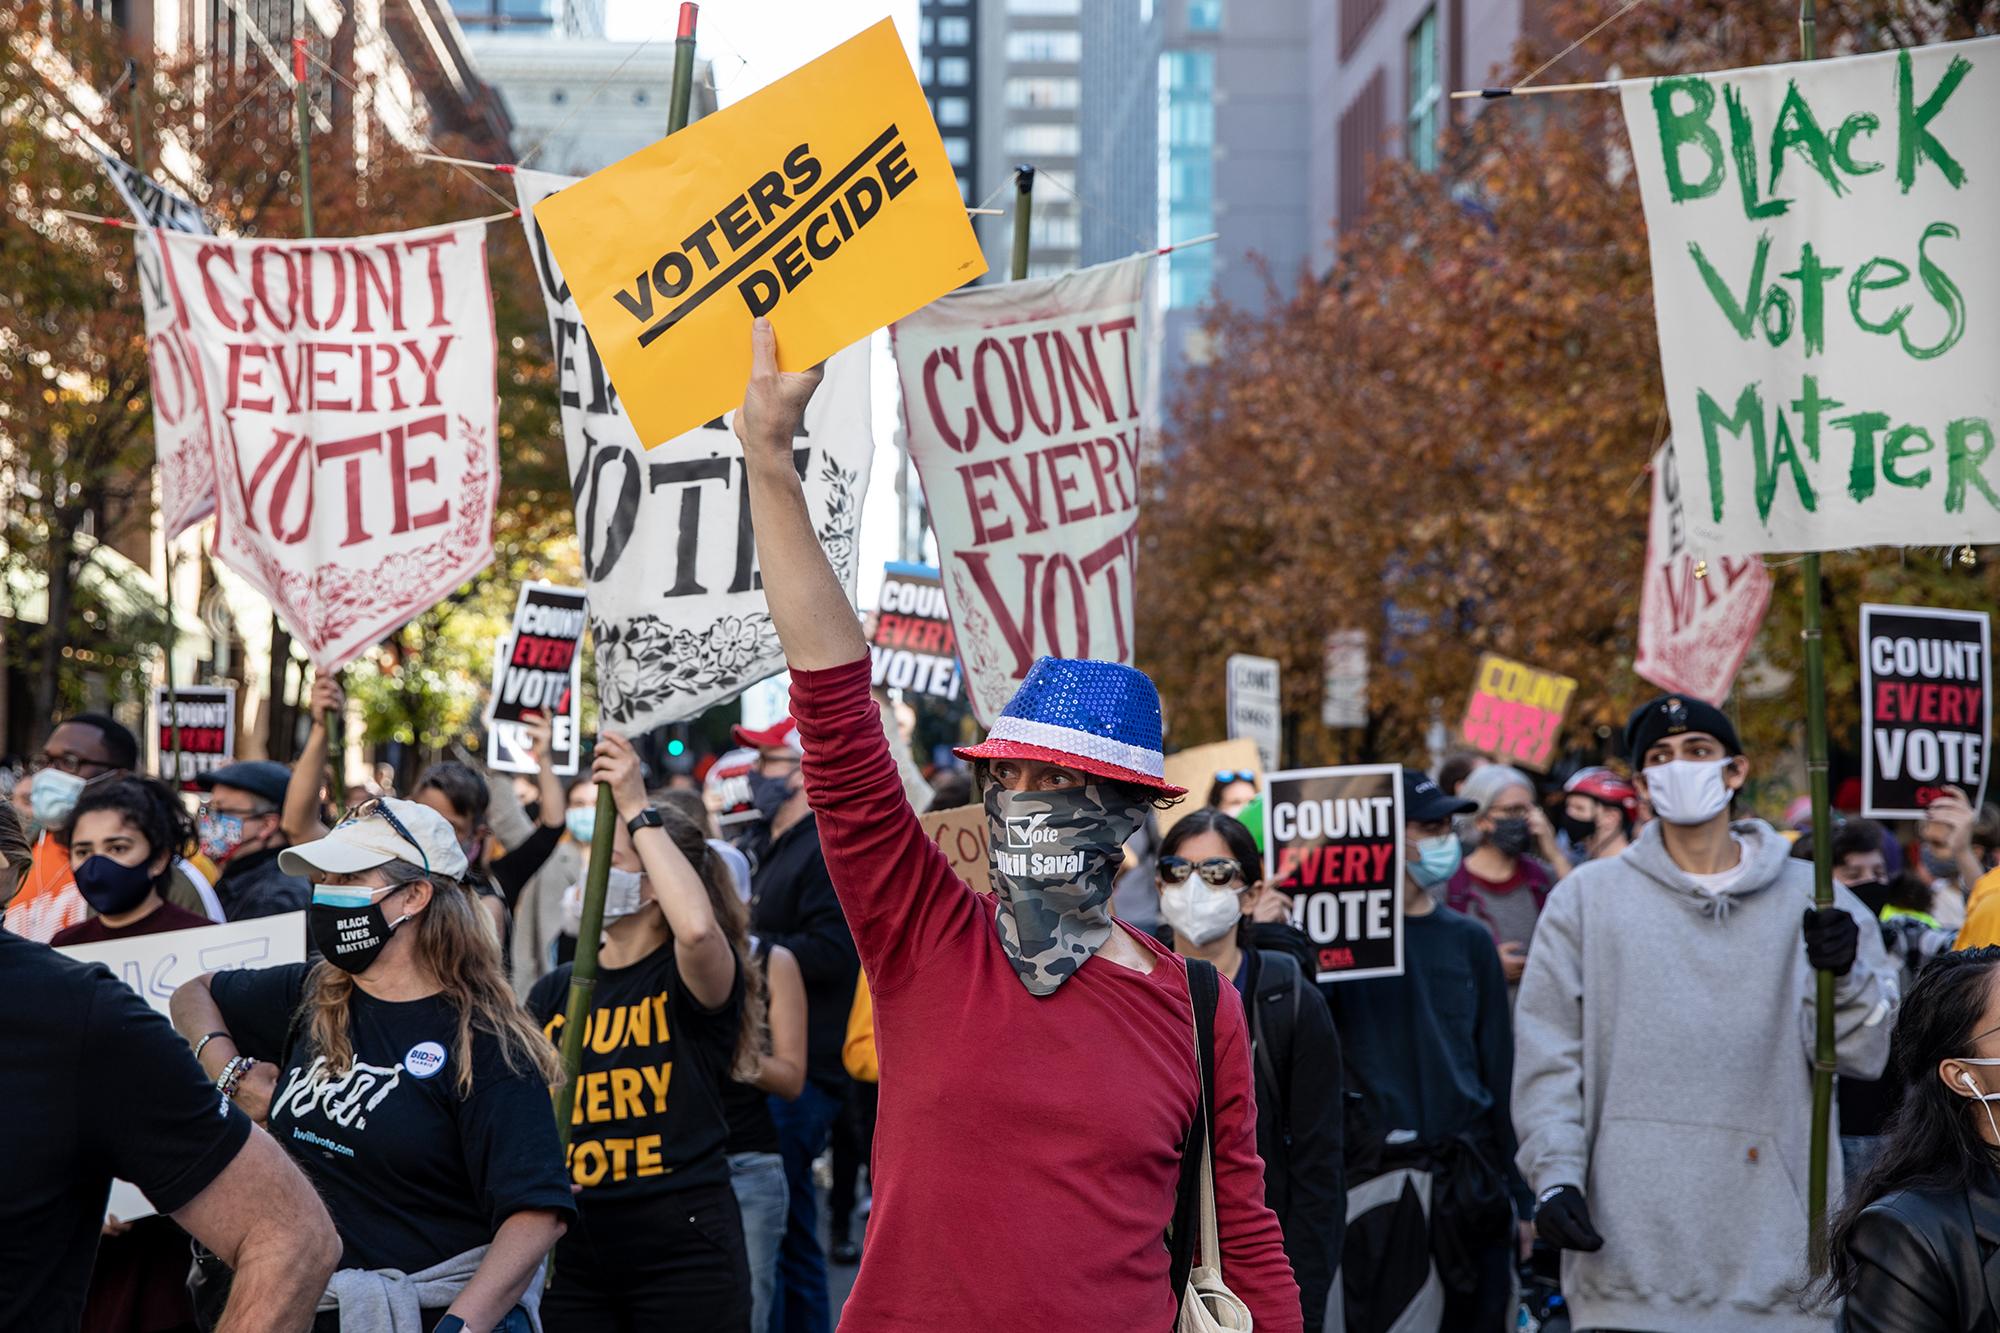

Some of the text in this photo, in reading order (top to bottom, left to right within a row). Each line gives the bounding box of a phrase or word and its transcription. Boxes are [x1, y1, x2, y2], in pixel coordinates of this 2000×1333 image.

[613, 142, 823, 323] VOTERS
[738, 140, 919, 318] DECIDE
[195, 232, 458, 334] COUNT
[224, 334, 459, 414] EVERY
[922, 315, 1139, 454] COUNT
[225, 413, 451, 548] VOTE
[955, 427, 1140, 546] EVERY
[880, 580, 950, 621] COUN
[954, 515, 1138, 680] VOT
[1870, 635, 1982, 682] COUNT
[1874, 680, 1983, 727] EVERY
[1874, 727, 1983, 785] VOTE
[1273, 796, 1393, 842] COUNT
[1031, 850, 1086, 876] Saval
[1277, 843, 1394, 888] EVERY
[335, 935, 380, 954] MATTER!
[336, 915, 370, 930] BLACK
[340, 927, 370, 942] LIVES
[410, 1049, 443, 1063] BIDEN
[549, 1061, 673, 1125] VERY
[293, 1126, 355, 1158] iwillvote.com
[565, 1133, 664, 1188] OTE
